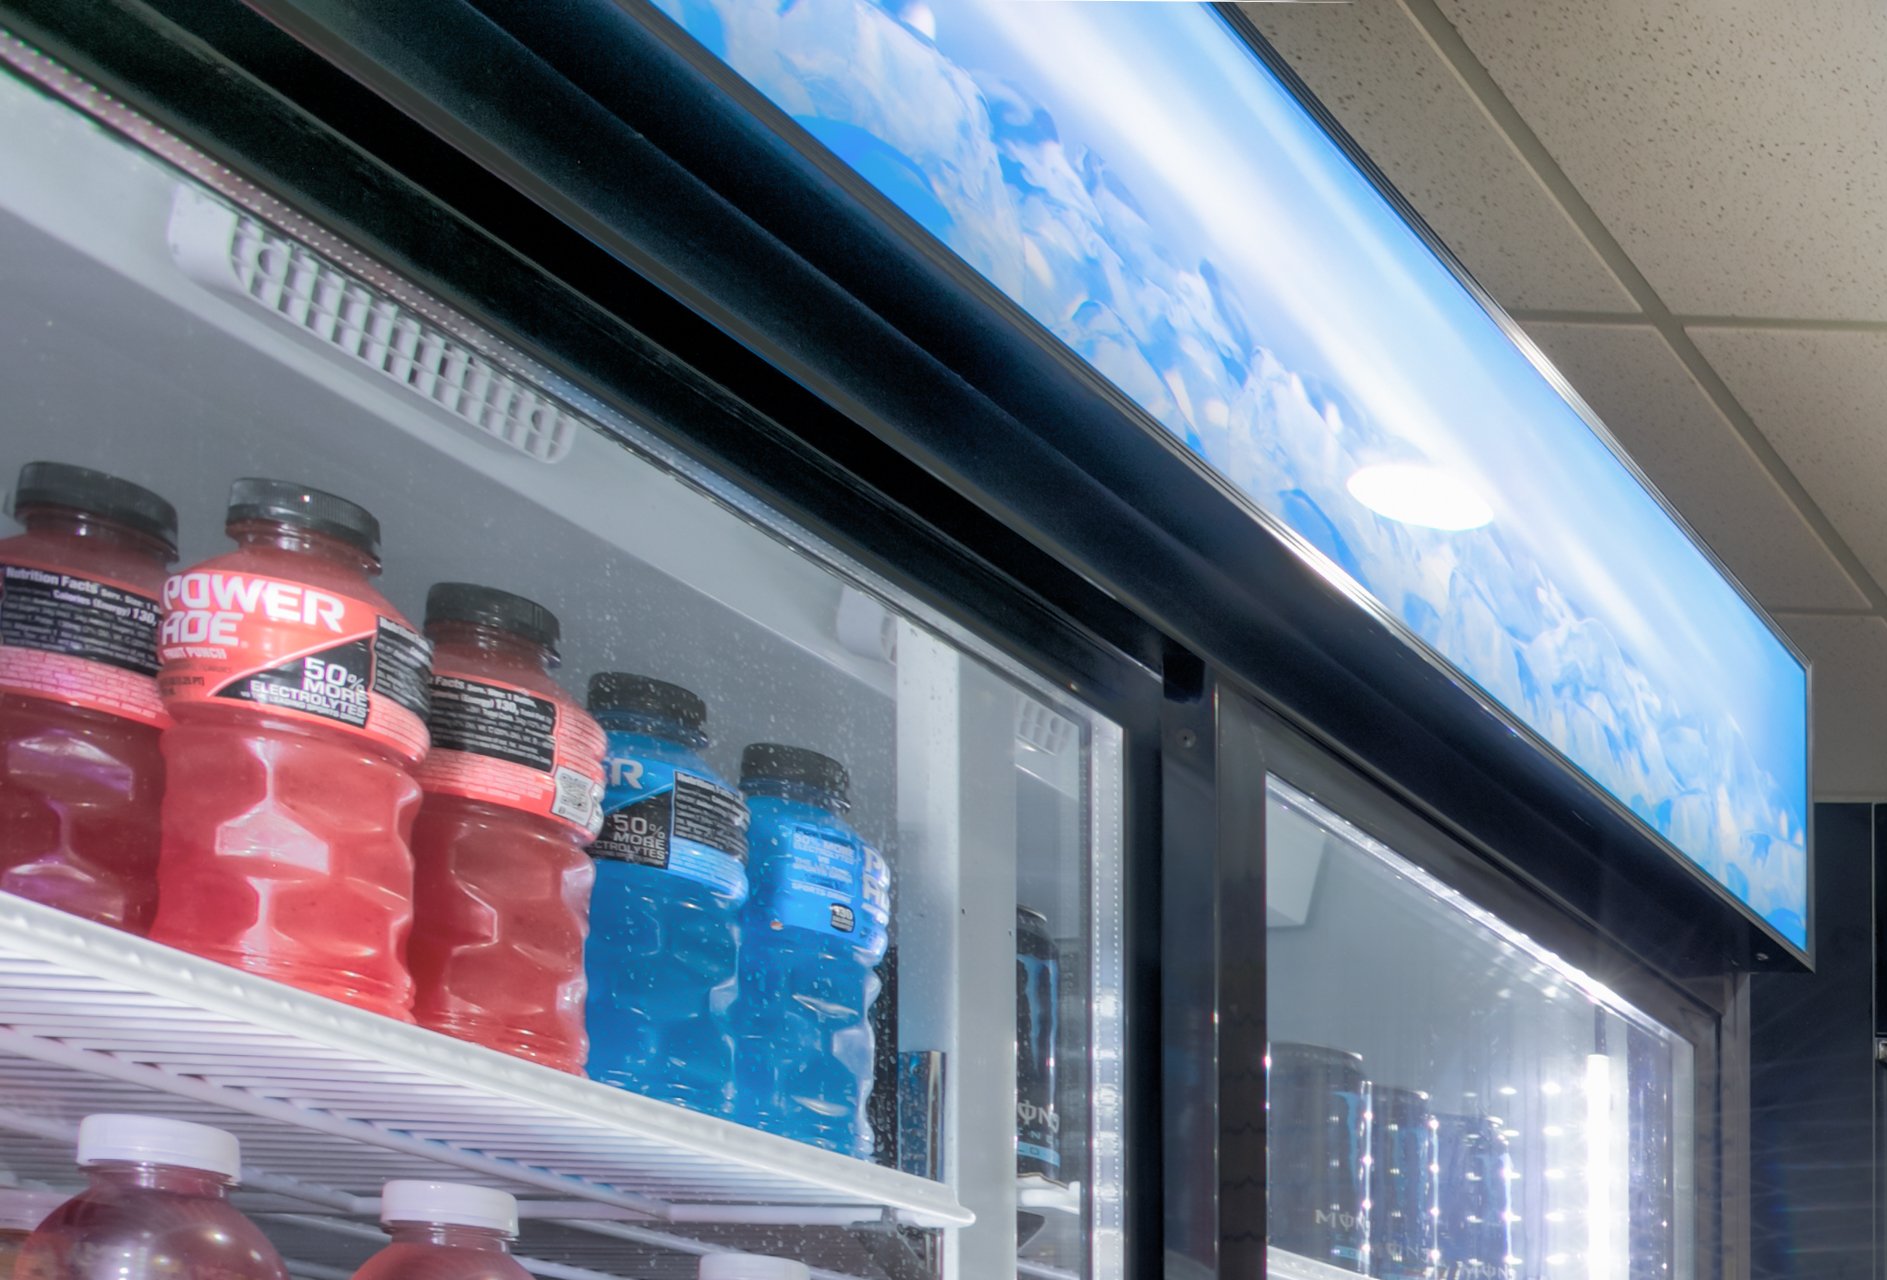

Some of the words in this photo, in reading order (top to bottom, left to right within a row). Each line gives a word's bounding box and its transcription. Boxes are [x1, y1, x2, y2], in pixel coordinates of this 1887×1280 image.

[61, 574, 98, 594] Facts
[163, 573, 344, 633] POWER
[161, 612, 243, 646] ADE
[304, 657, 365, 692] 50%
[303, 681, 365, 706] MORE
[612, 814, 666, 838] 50%
[613, 832, 666, 849] MORE
